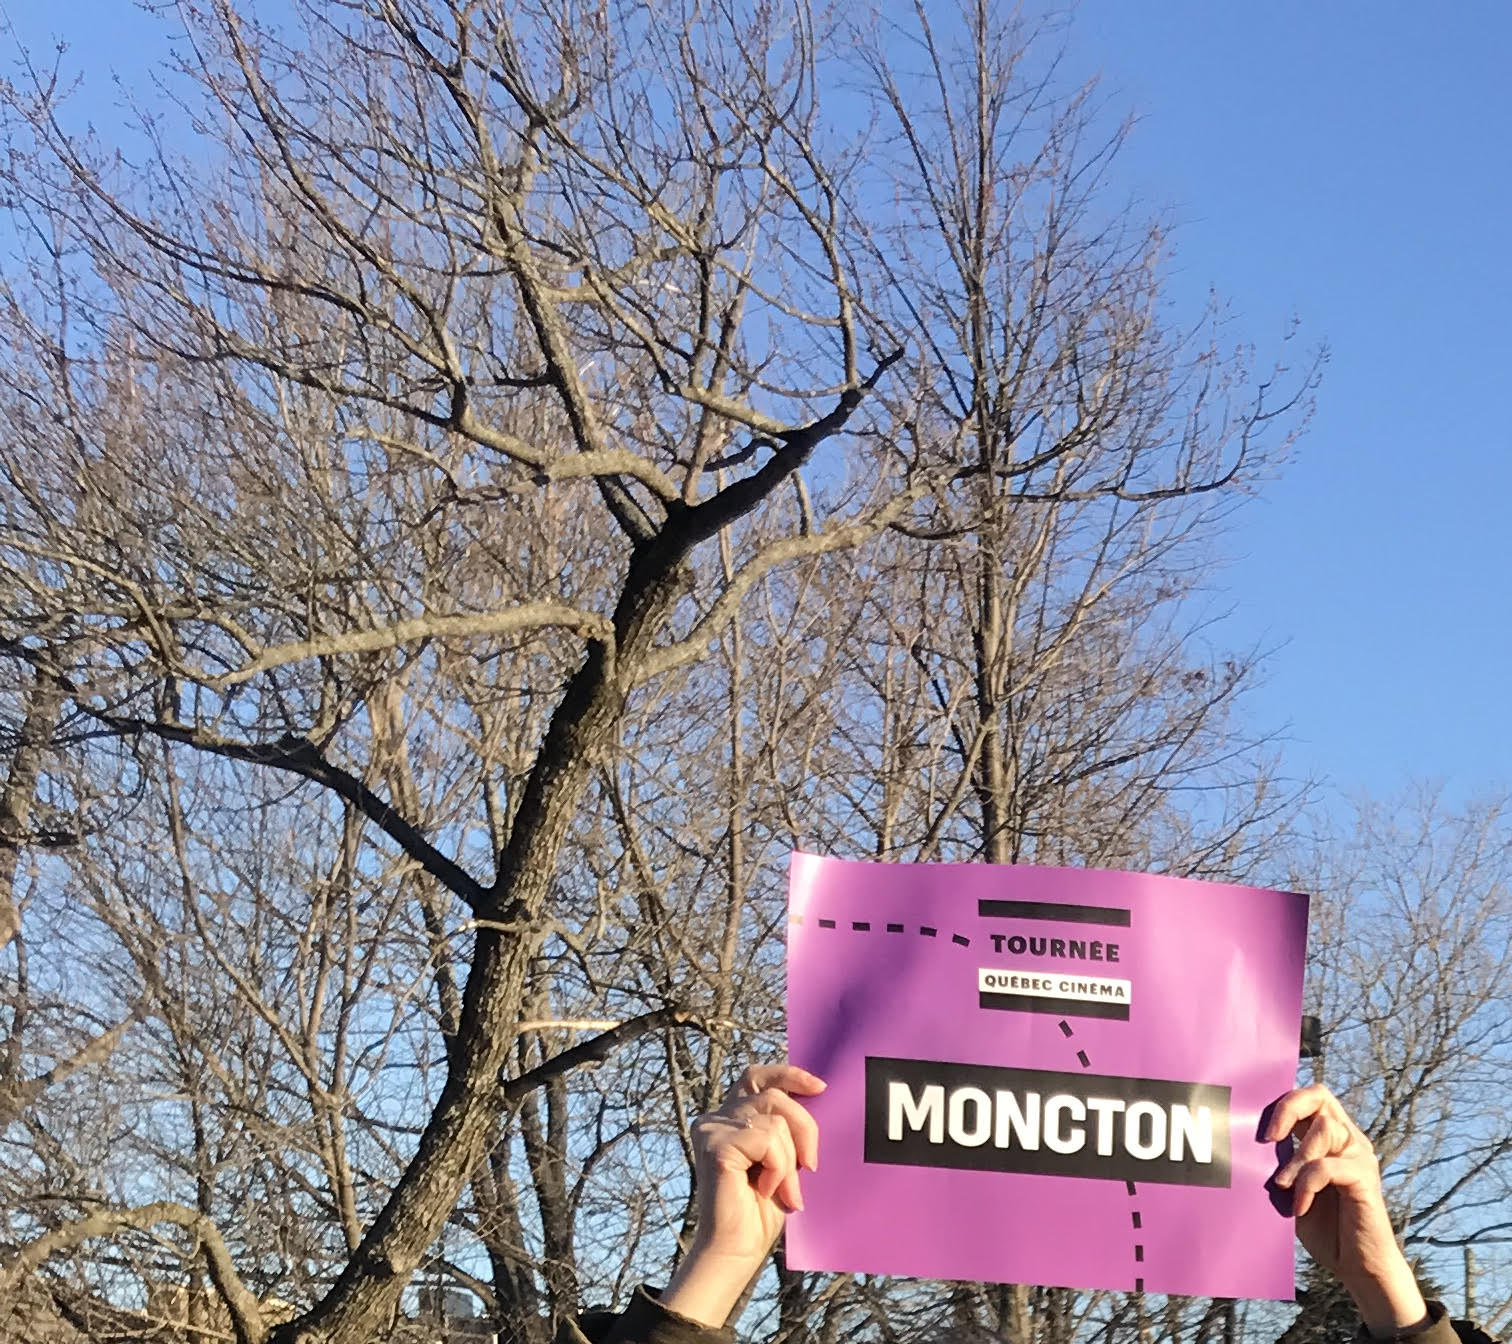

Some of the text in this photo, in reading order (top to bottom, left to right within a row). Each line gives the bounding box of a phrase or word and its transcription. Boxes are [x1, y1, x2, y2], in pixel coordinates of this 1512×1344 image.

[990, 934, 1120, 962] TOURNÉE
[984, 974, 1126, 998] QUÉBEC CINÉMA
[887, 1081, 1213, 1164] MONCTON
